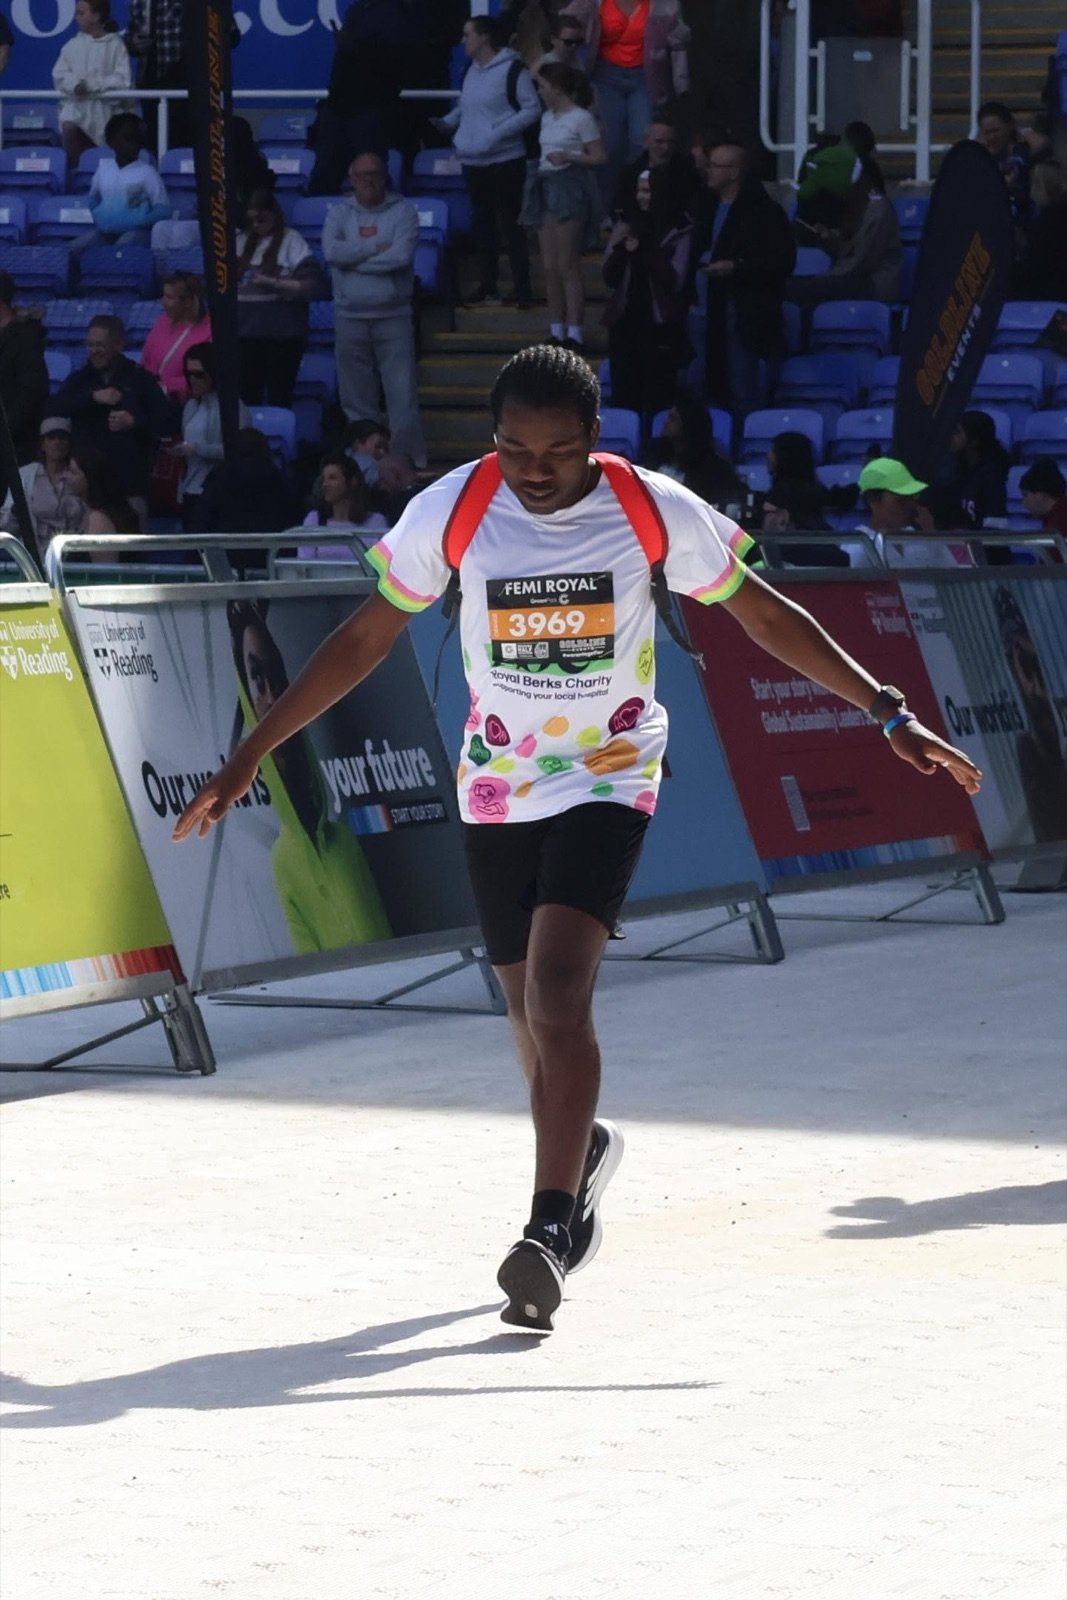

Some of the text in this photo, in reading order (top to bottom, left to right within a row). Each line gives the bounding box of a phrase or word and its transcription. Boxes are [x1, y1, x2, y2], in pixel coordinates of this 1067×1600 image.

[946, 302, 983, 383] EVENTS
[505, 577, 597, 595] FEMI ROYAL
[9, 617, 60, 644] University of
[103, 620, 147, 646] University of
[509, 610, 585, 637] 3969
[17, 644, 74, 682] Reading
[111, 647, 159, 683] Reading
[490, 669, 613, 690] Royal Berks Charity
[533, 691, 552, 701] your
[554, 691, 576, 701] local
[946, 695, 975, 737] Our
[142, 761, 188, 819] Our
[319, 755, 374, 815] your
[364, 739, 438, 794] future
